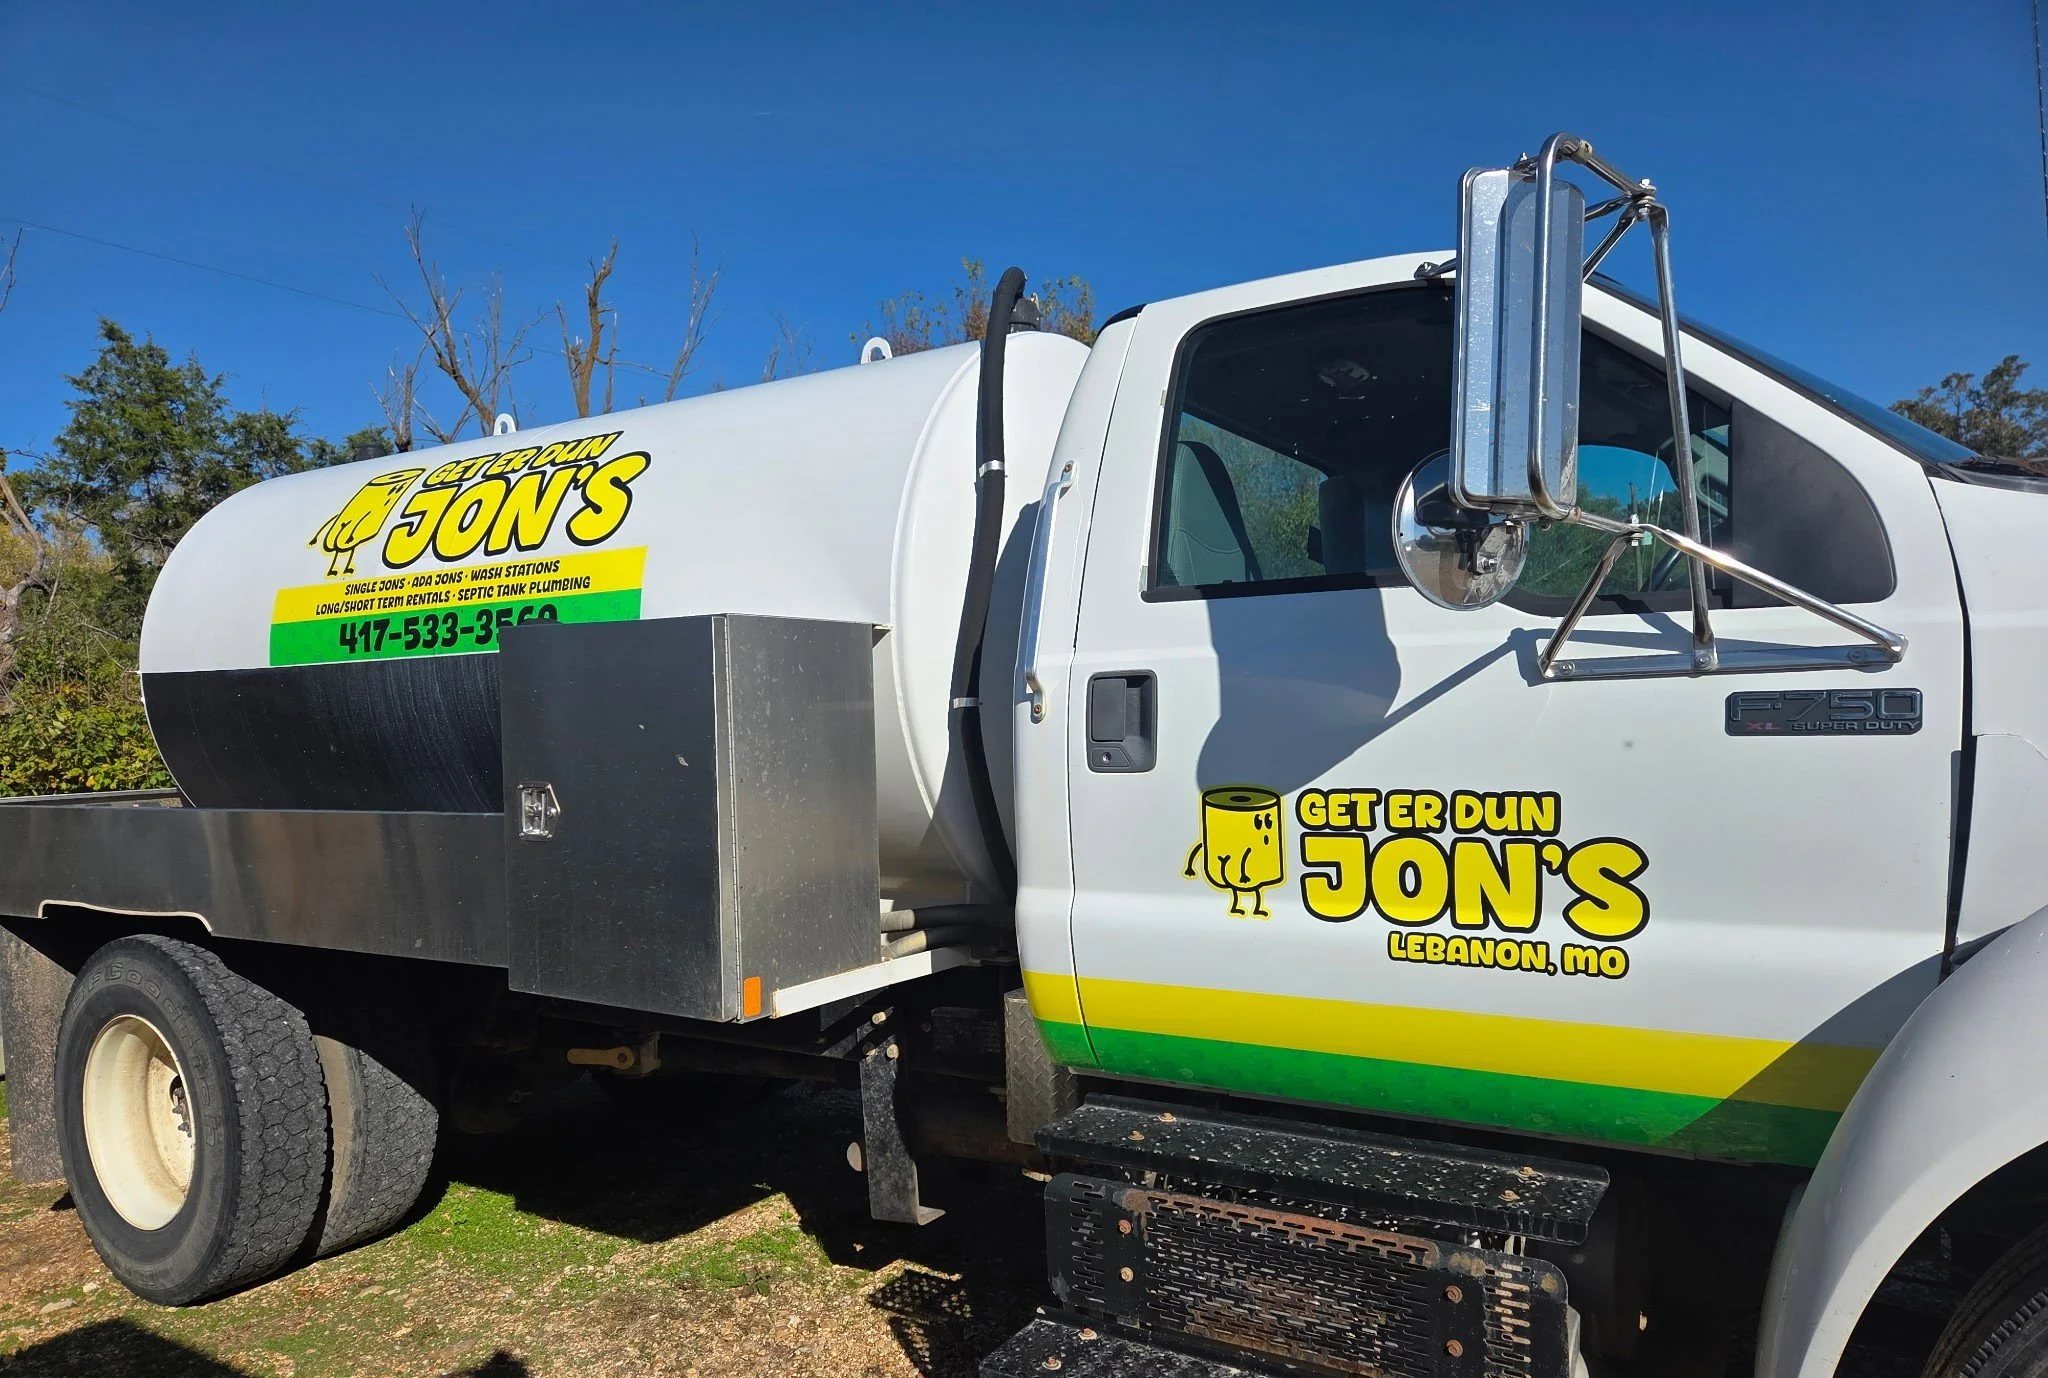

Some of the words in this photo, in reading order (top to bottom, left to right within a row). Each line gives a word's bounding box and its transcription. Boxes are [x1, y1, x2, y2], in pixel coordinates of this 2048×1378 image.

[421, 455, 487, 489] GET
[486, 445, 539, 476] ER
[533, 431, 624, 467] DUN
[381, 451, 652, 570] JON'S
[316, 598, 375, 616] LONG/SHORT
[377, 596, 405, 609] TERM
[406, 590, 451, 607] RENTALS
[457, 586, 495, 602] SEPTIC
[496, 582, 527, 598] TANK
[529, 576, 591, 595] PLUMBING
[344, 581, 377, 596] SINGLE
[378, 578, 406, 592] JONS
[411, 575, 433, 588] ADA
[434, 571, 464, 586] JONS
[471, 567, 503, 582] WASH
[505, 560, 560, 578] STATIONS
[1745, 721, 1782, 731] XL
[1791, 721, 1858, 731] SUPER
[1865, 720, 1921, 731] DUTY
[1296, 787, 1383, 832] GET
[1383, 789, 1449, 834] ER
[1450, 791, 1562, 837] DUN
[1299, 831, 1651, 942] JON'S
[1386, 931, 1557, 975] LEBANON,
[1560, 943, 1630, 980] MO
